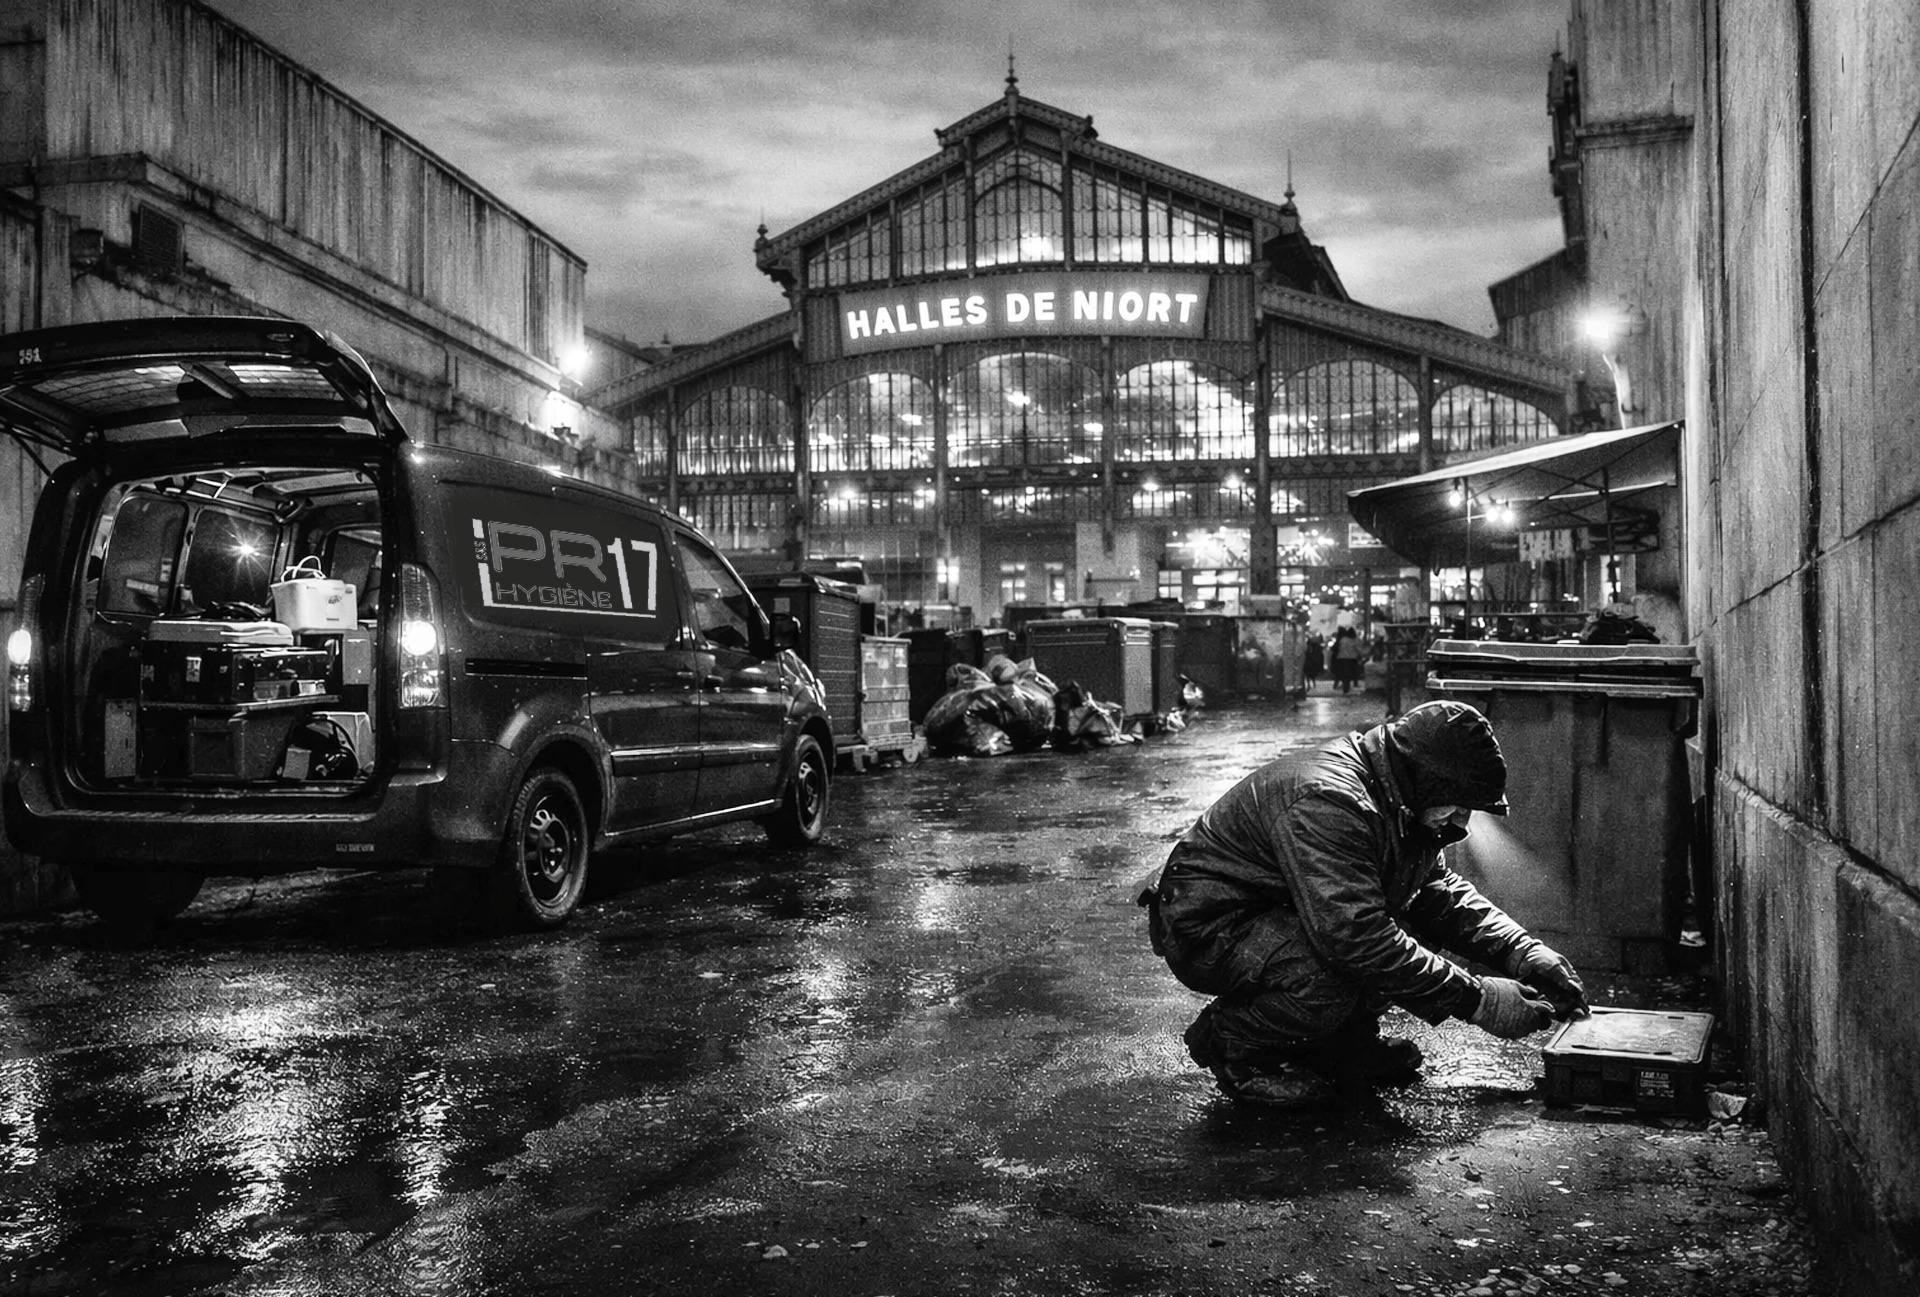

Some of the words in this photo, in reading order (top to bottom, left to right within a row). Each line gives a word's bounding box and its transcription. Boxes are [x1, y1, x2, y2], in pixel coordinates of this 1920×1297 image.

[846, 295, 988, 339] HALLES
[1006, 292, 1055, 322] DE
[1073, 290, 1198, 323] NIORT
[495, 583, 612, 608] HYGIÈNE
